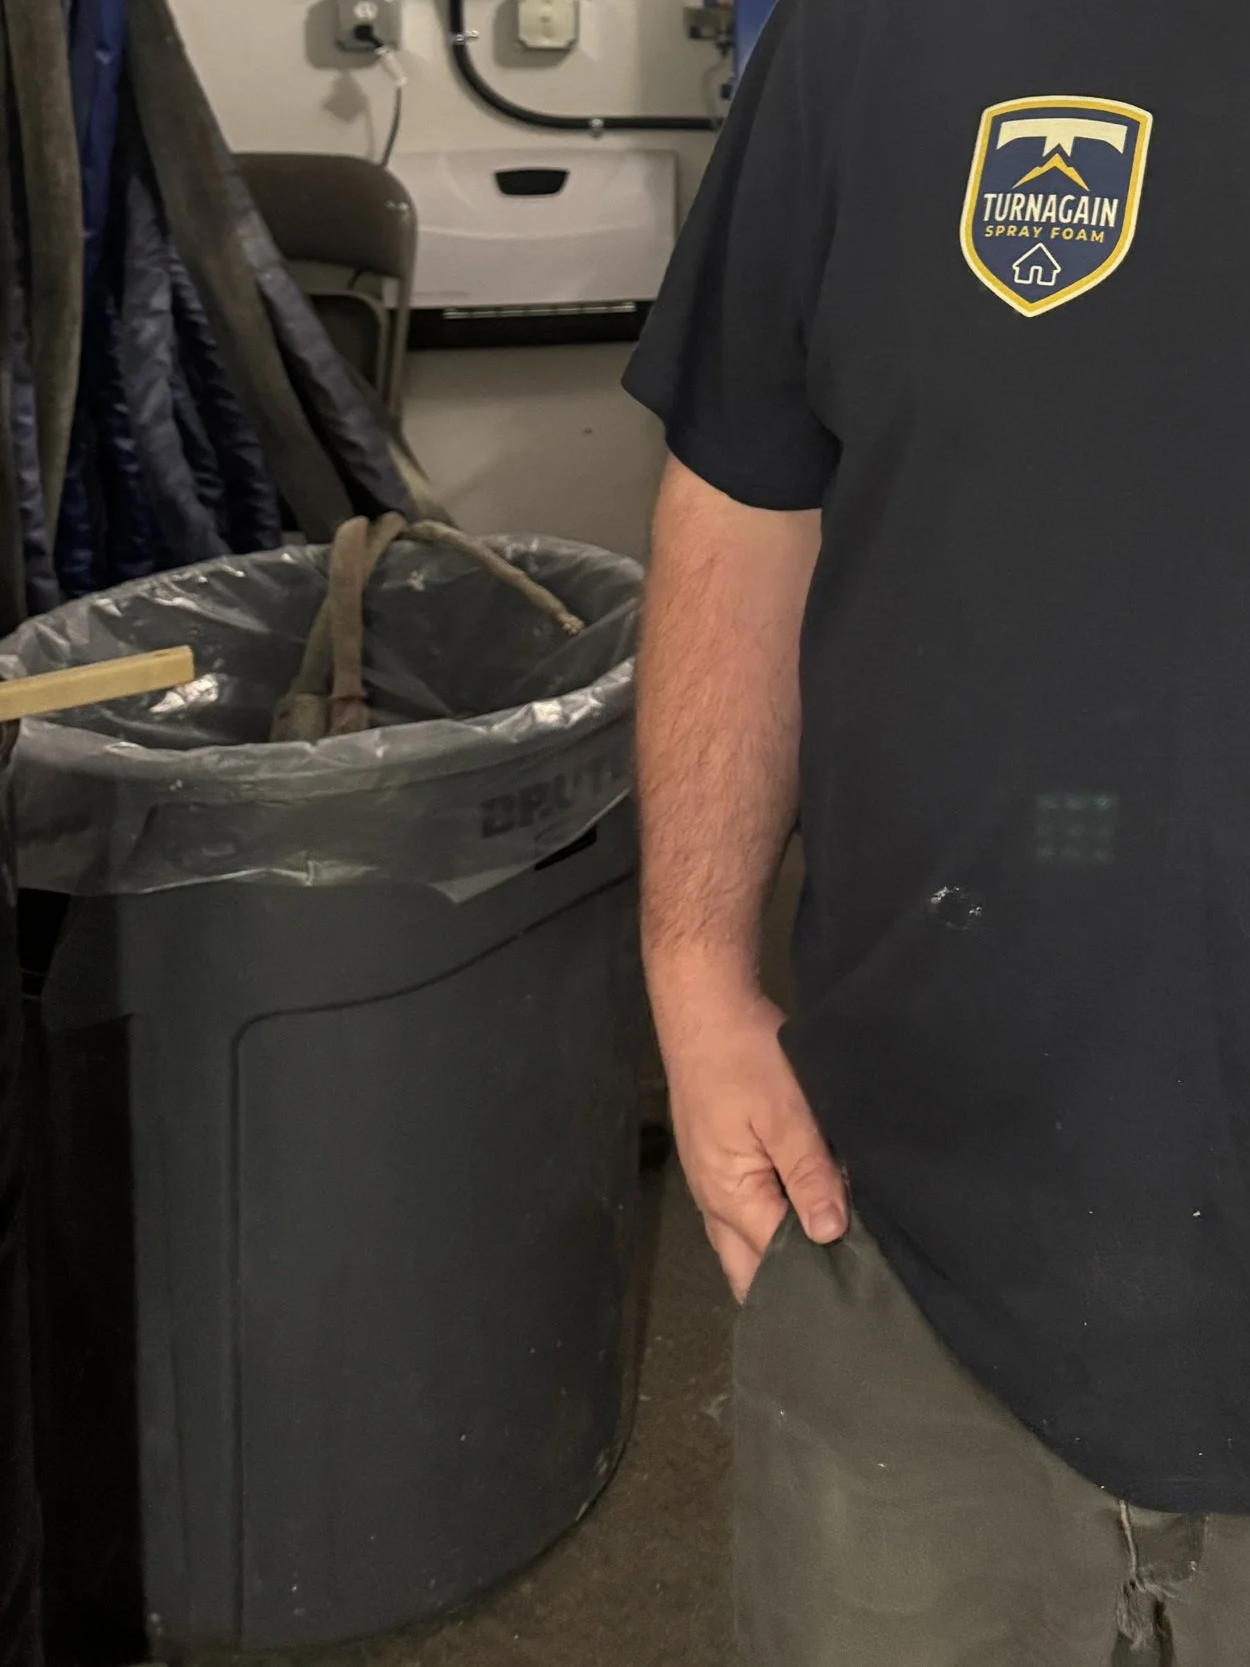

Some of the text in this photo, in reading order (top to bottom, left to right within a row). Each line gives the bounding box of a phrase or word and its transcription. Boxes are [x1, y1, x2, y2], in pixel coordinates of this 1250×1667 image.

[983, 193, 1119, 227] TURNAGAIN
[984, 224, 1105, 243] SPRAY FOAM
